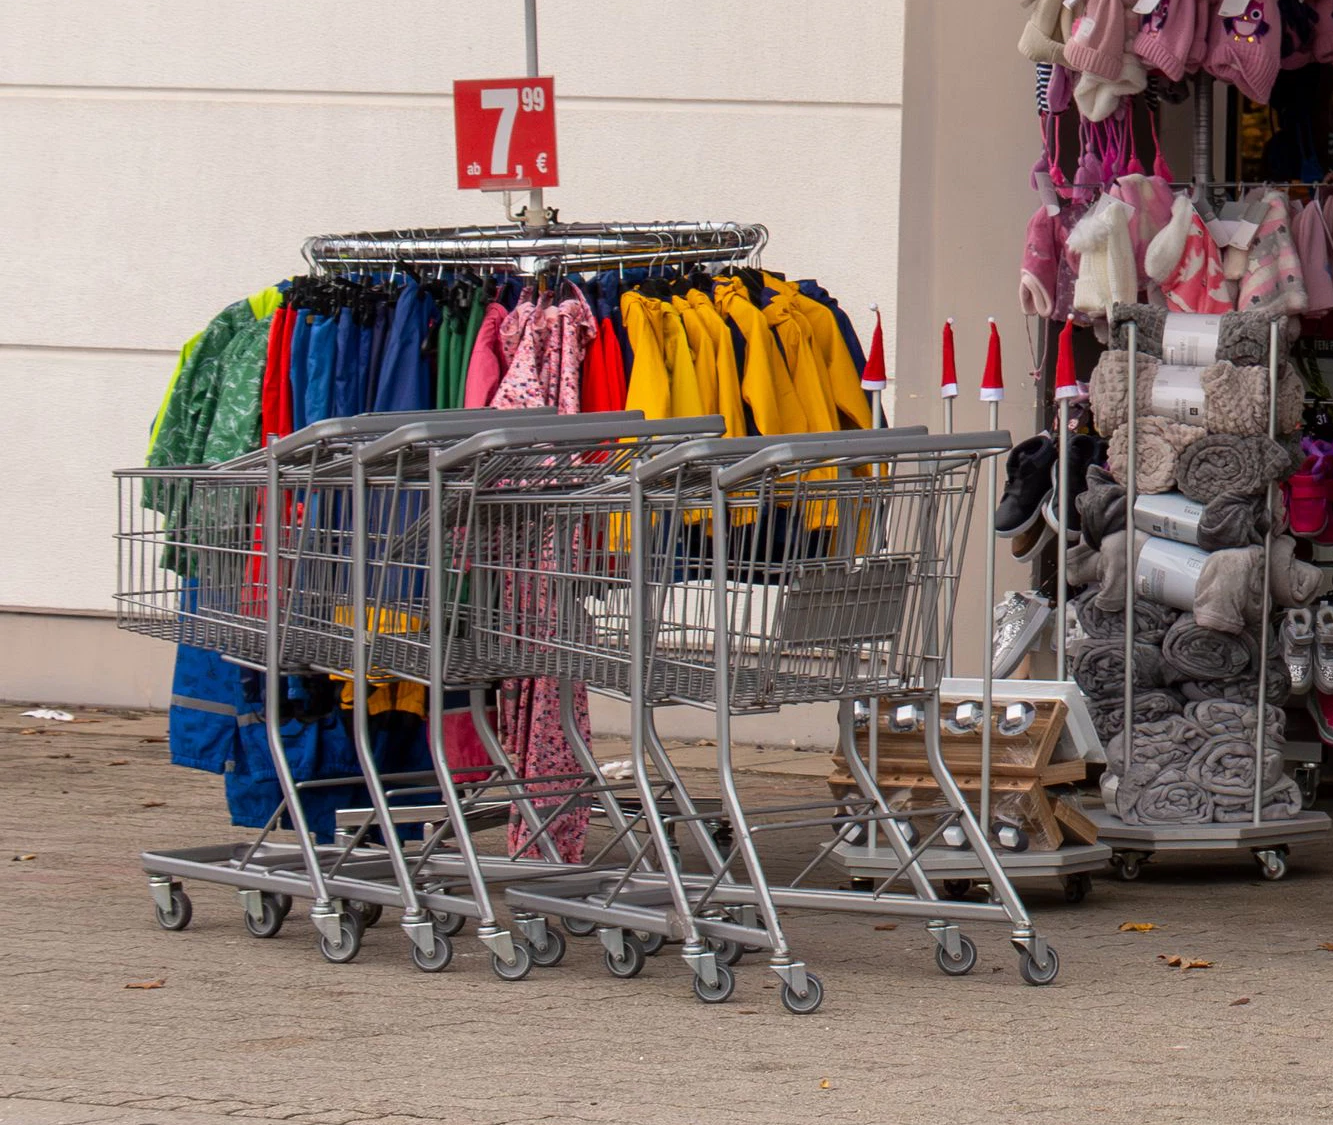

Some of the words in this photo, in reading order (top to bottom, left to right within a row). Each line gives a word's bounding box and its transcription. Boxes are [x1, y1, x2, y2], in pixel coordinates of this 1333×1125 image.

[466, 161, 481, 175] ab
[536, 152, 548, 173] €
[1316, 415, 1327, 425] 31
